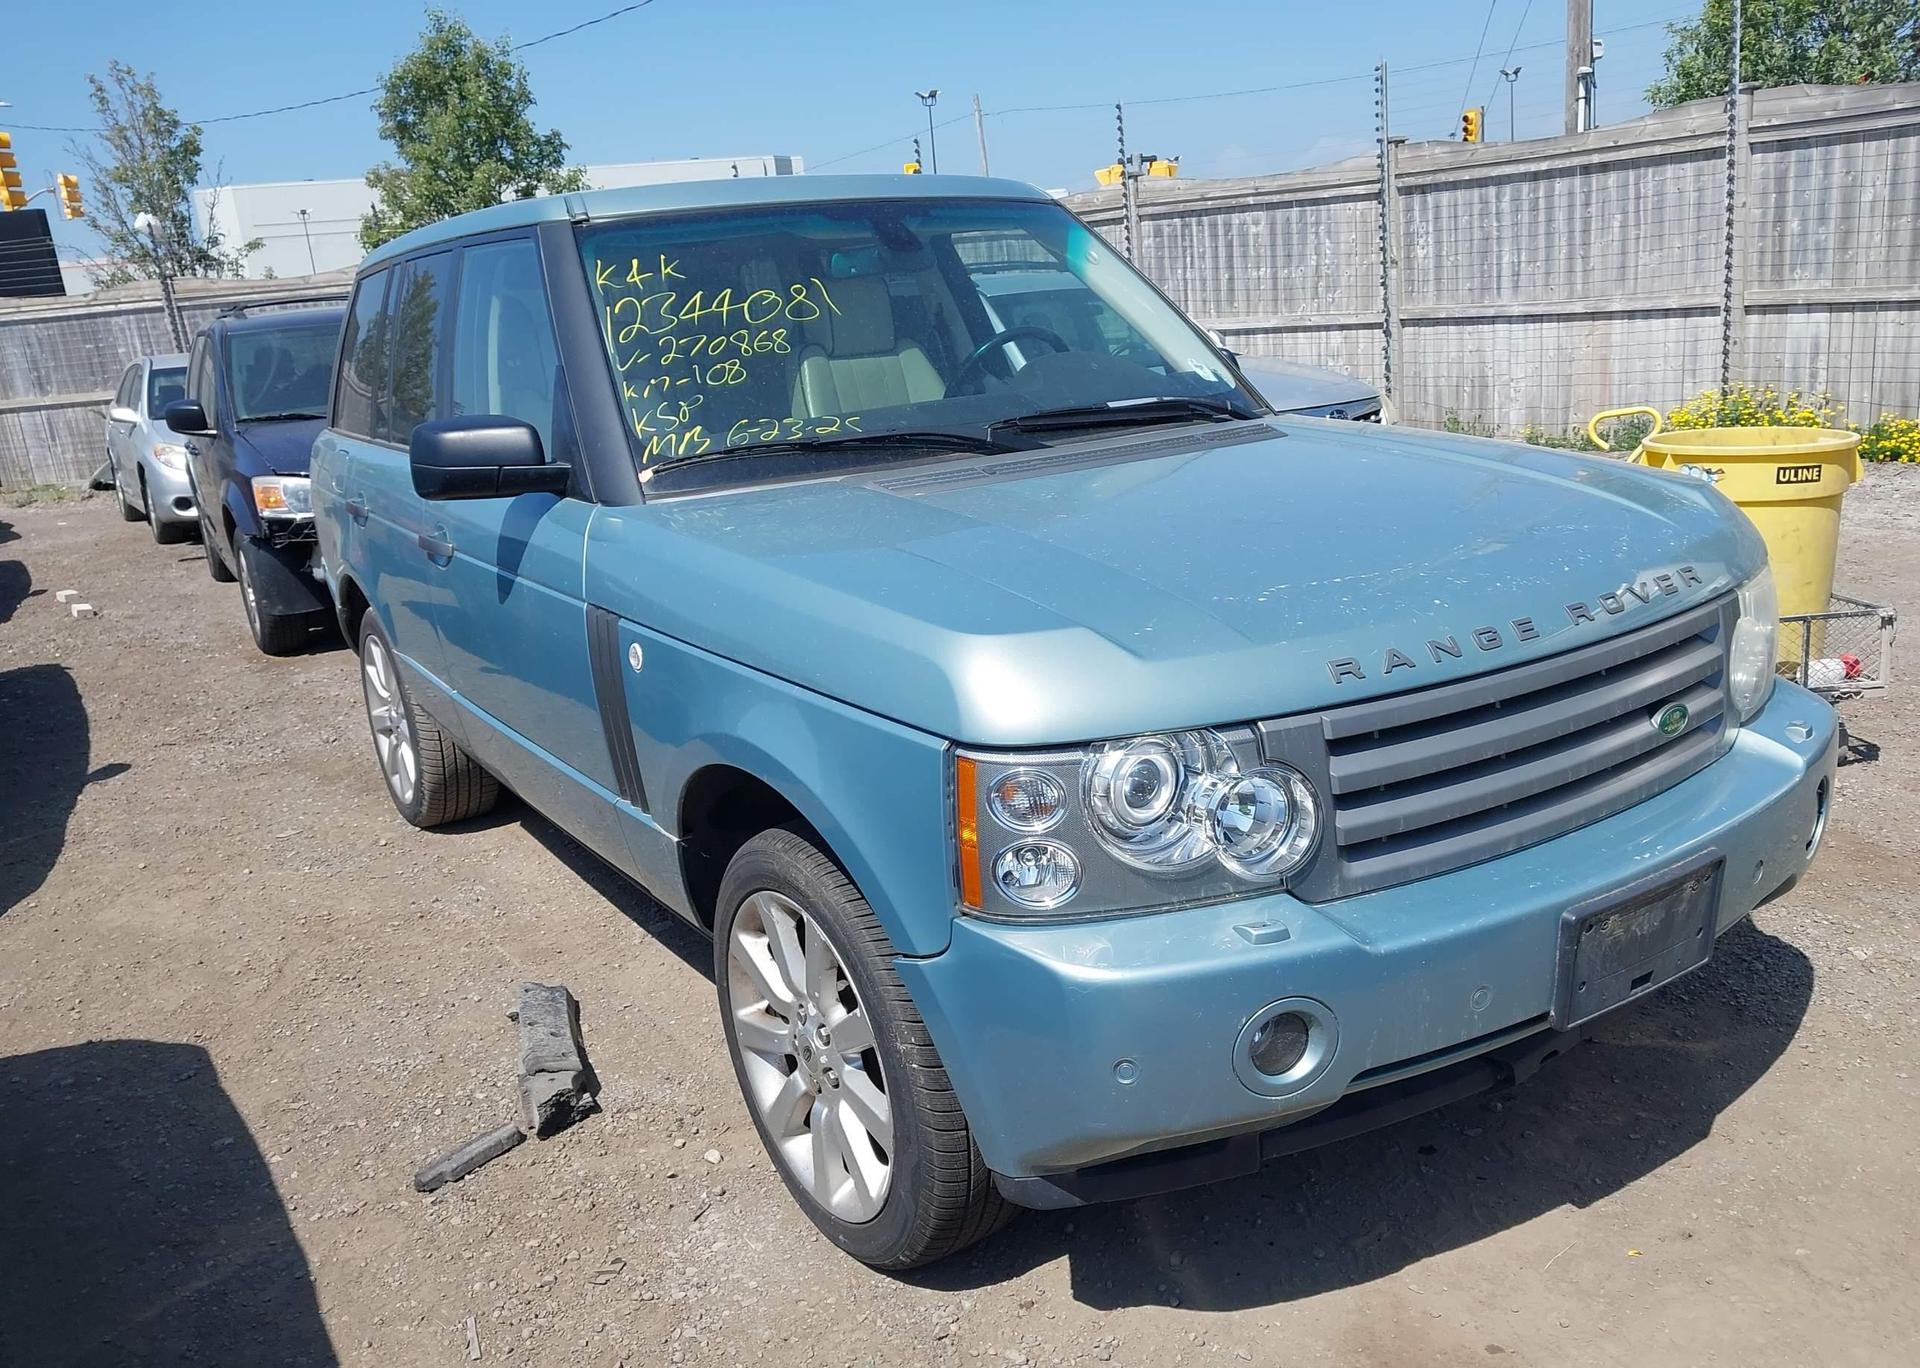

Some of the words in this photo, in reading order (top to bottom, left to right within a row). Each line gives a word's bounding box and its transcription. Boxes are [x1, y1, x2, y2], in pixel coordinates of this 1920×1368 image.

[605, 277, 842, 354] 12344081
[1778, 467, 1820, 482] ULINE
[1326, 616, 1541, 685] RANGE
[1562, 564, 1703, 626] ROVER
